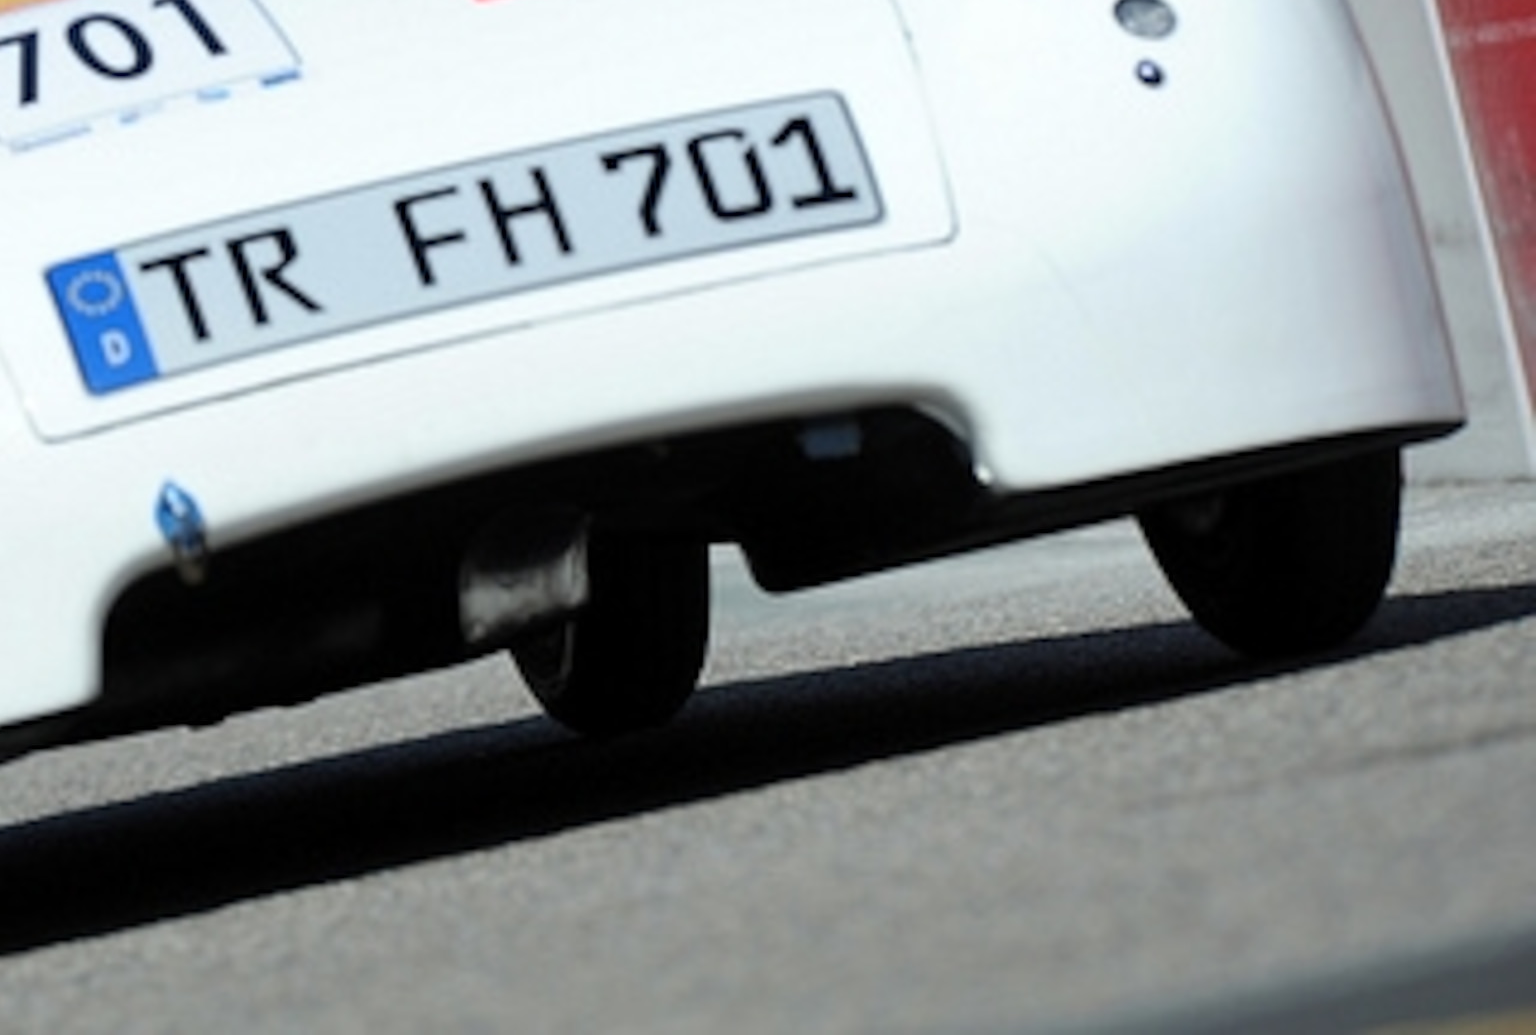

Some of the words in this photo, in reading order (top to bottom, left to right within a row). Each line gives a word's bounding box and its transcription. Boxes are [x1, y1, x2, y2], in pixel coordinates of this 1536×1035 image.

[138, 226, 323, 342] TR
[392, 166, 573, 286] FH
[599, 116, 858, 238] 701
[100, 330, 131, 366] D
